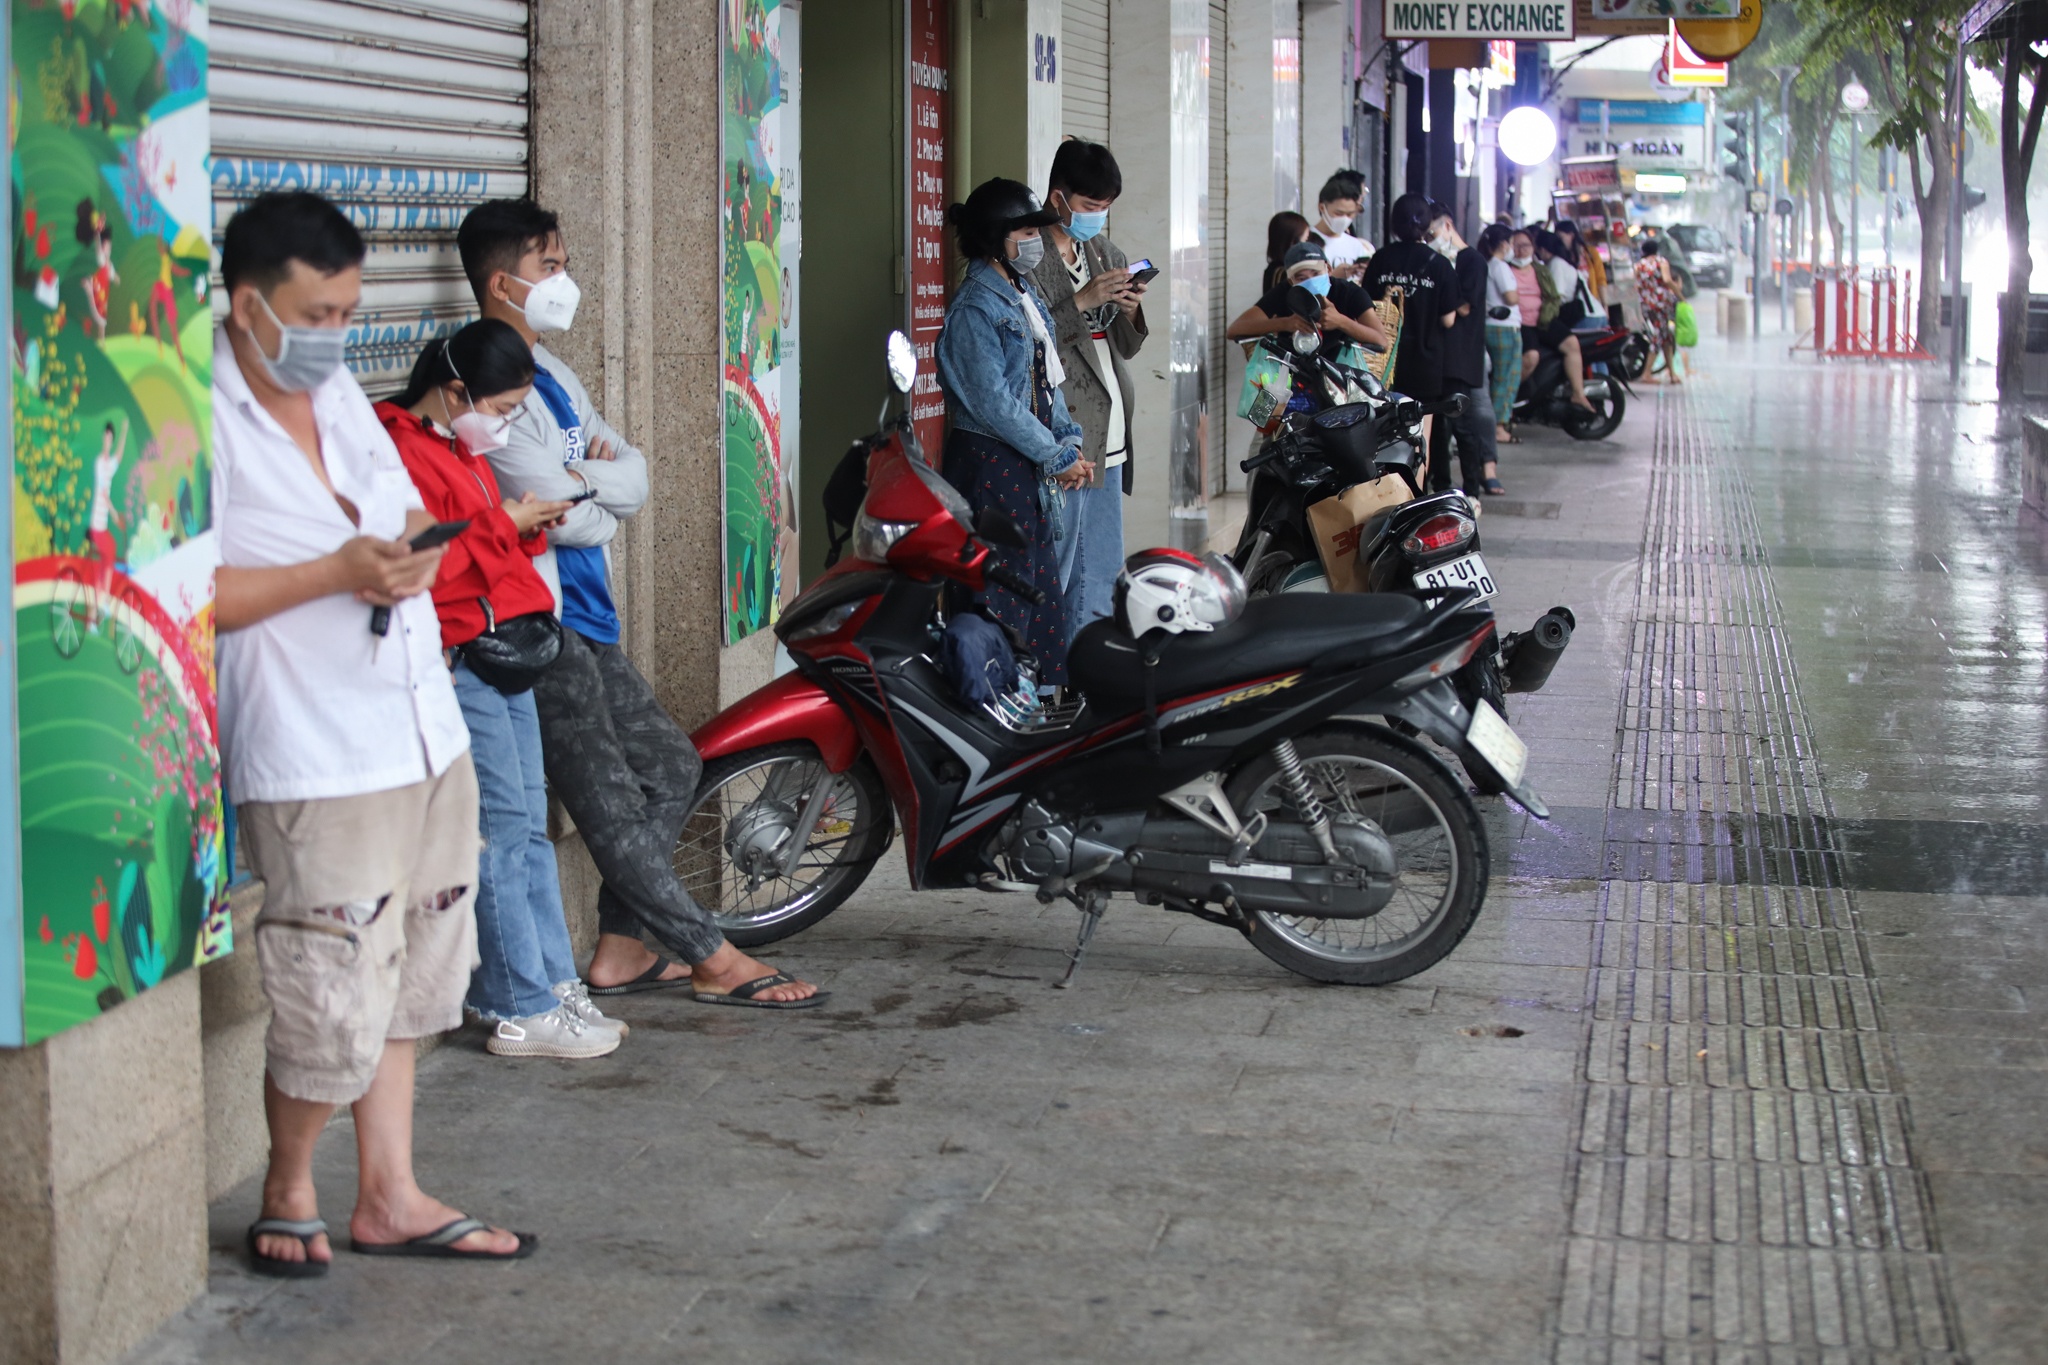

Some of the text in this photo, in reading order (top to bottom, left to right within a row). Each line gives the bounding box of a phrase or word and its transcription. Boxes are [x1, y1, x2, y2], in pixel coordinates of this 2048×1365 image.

[1393, 3, 1459, 31] MONEY
[1467, 4, 1565, 33] EXCHANGE
[1034, 32, 1056, 84] 92-96
[911, 51, 948, 97] TUYỂN DỤNG
[917, 104, 923, 126] 1.
[917, 137, 923, 159] 2.
[917, 170, 923, 192] 3.
[782, 200, 796, 223] CAO
[917, 203, 923, 225] 4.
[917, 237, 923, 258] 5.
[1421, 276, 1436, 289] vie
[1425, 559, 1478, 591] 81-U1
[752, 976, 775, 989] SPORT
